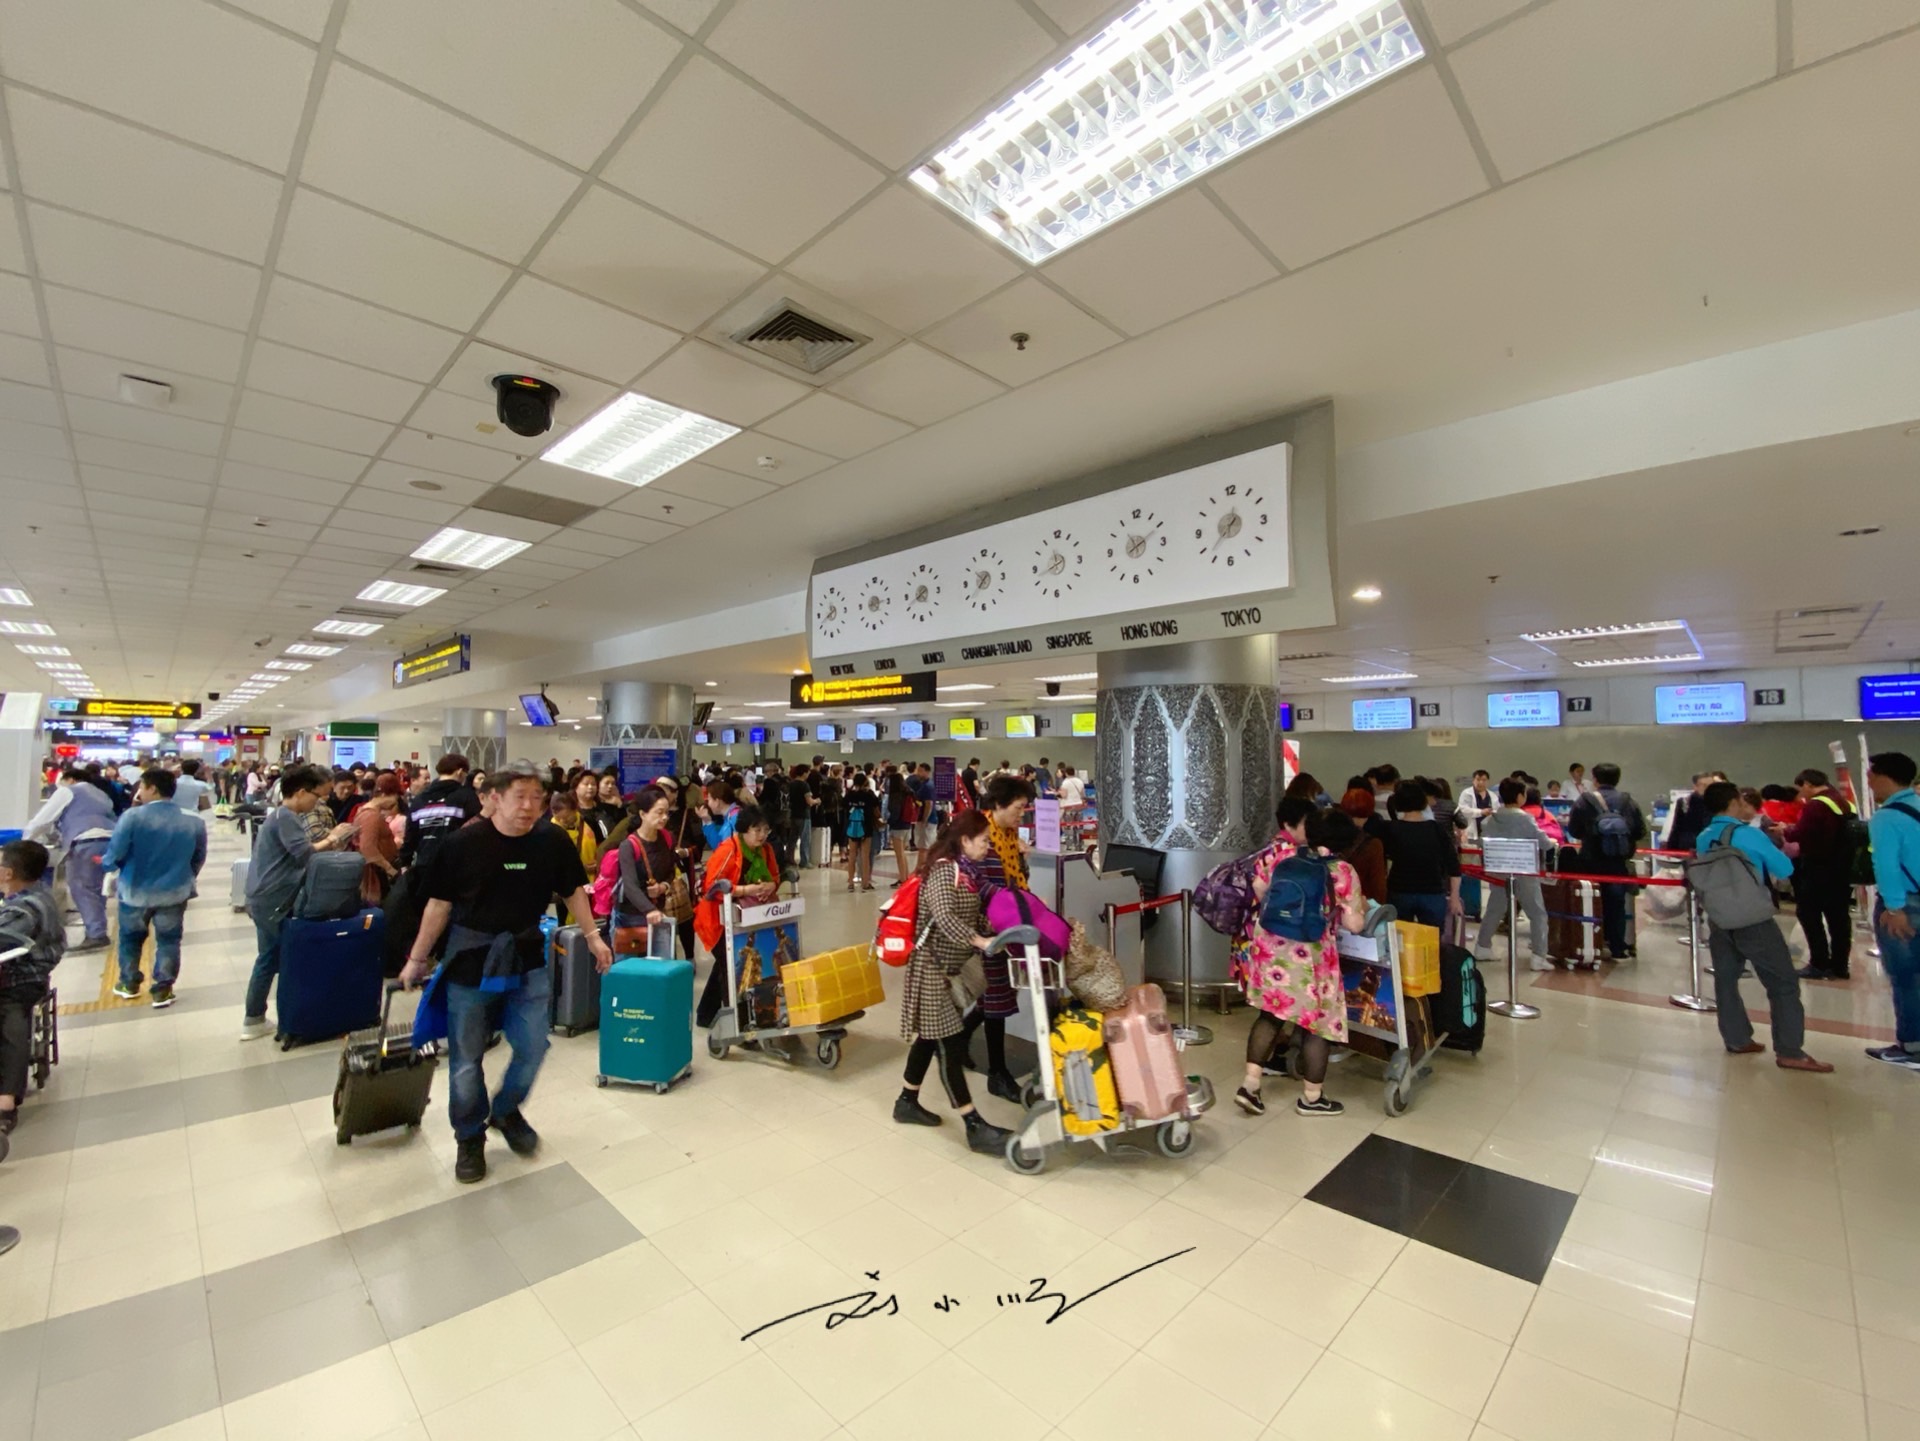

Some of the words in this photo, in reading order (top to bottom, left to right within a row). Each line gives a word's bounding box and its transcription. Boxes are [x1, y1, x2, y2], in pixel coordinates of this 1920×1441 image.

[1225, 485, 1236, 496] 12
[1132, 509, 1141, 519] 12
[1260, 514, 1268, 525] 3
[1053, 529, 1061, 539] 12
[1195, 529, 1202, 539] 9
[1160, 536, 1166, 546] 3
[980, 549, 987, 557] 12
[1107, 548, 1113, 558] 9
[1077, 555, 1083, 564] 3
[1227, 555, 1234, 566] 6
[1032, 565, 1038, 574] 9
[1001, 572, 1005, 580] 3
[1133, 574, 1139, 584] 6
[963, 580, 968, 588] 9
[936, 586, 941, 594] 3
[1054, 589, 1060, 598] 6
[981, 603, 986, 611] 6
[1221, 607, 1261, 627] TOKYO
[1120, 623, 1148, 640] HONG
[1150, 620, 1178, 637] KONG
[1046, 631, 1093, 649] SINGAPORE
[922, 651, 945, 665] MUNICH
[830, 665, 841, 676] NEW
[842, 663, 856, 674] YORK
[873, 658, 896, 671] LONDON
[1759, 690, 1780, 705] 18
[1422, 703, 1437, 716] 16
[1571, 698, 1587, 711] 17
[1300, 708, 1311, 719] 15
[771, 903, 792, 917] Gulf
